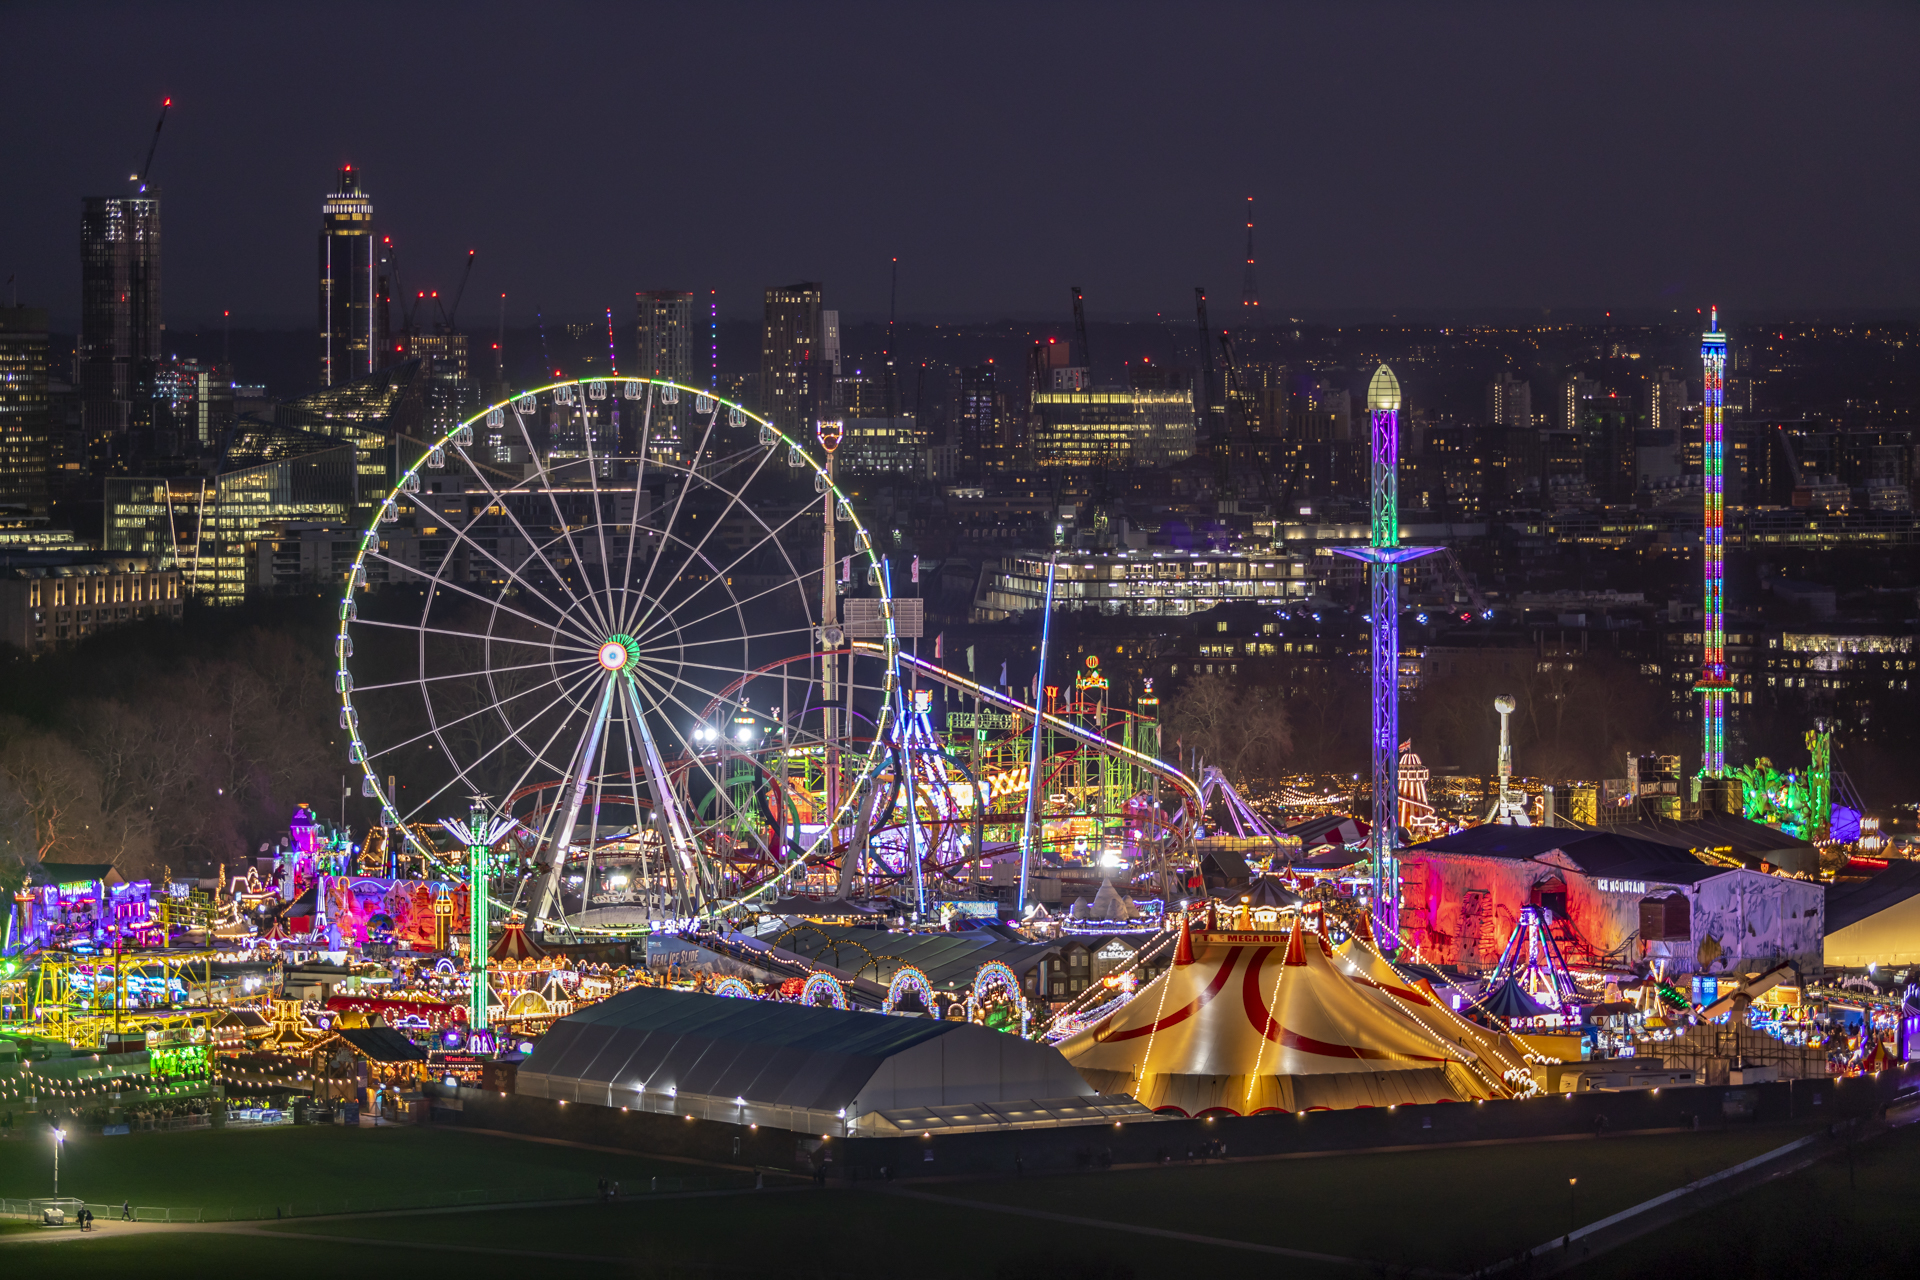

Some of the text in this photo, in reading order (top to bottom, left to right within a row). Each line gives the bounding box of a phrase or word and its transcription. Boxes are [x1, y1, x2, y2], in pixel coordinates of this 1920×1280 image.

[1641, 782, 1677, 794] DAEMNIUM
[1598, 879, 1645, 893] ICE MOUNTAIN
[653, 954, 667, 966] REAL
[681, 950, 699, 962] SLIDE
